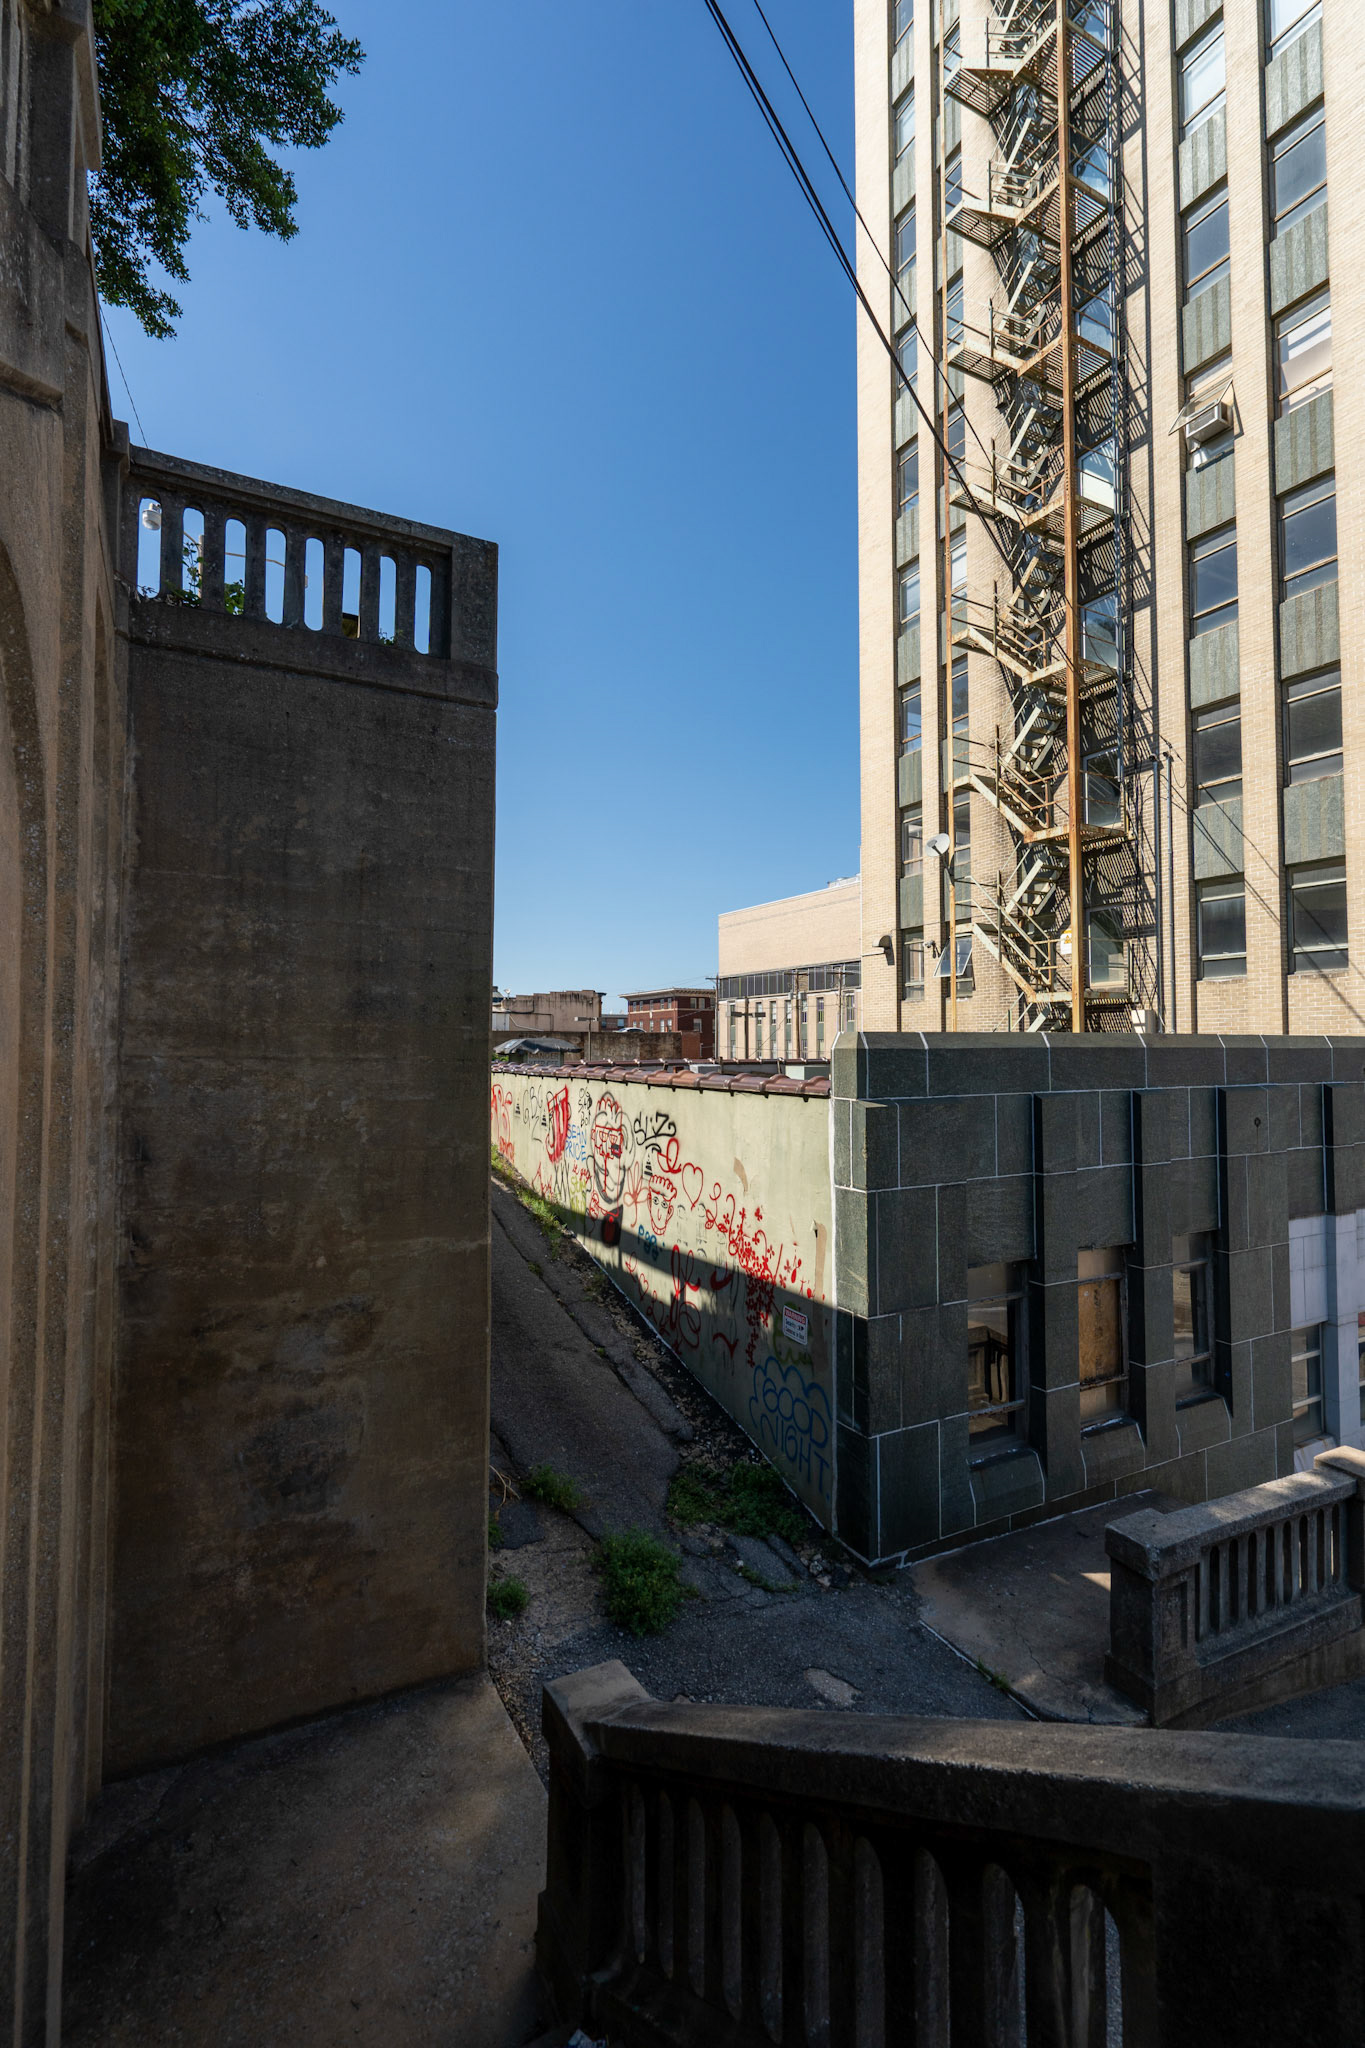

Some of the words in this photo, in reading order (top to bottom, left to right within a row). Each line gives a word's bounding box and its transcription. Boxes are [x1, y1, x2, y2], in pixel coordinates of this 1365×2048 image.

[567, 1124, 587, 1145] SEAN
[565, 1139, 587, 1162] PRICE
[763, 1377, 829, 1449] GOOD
